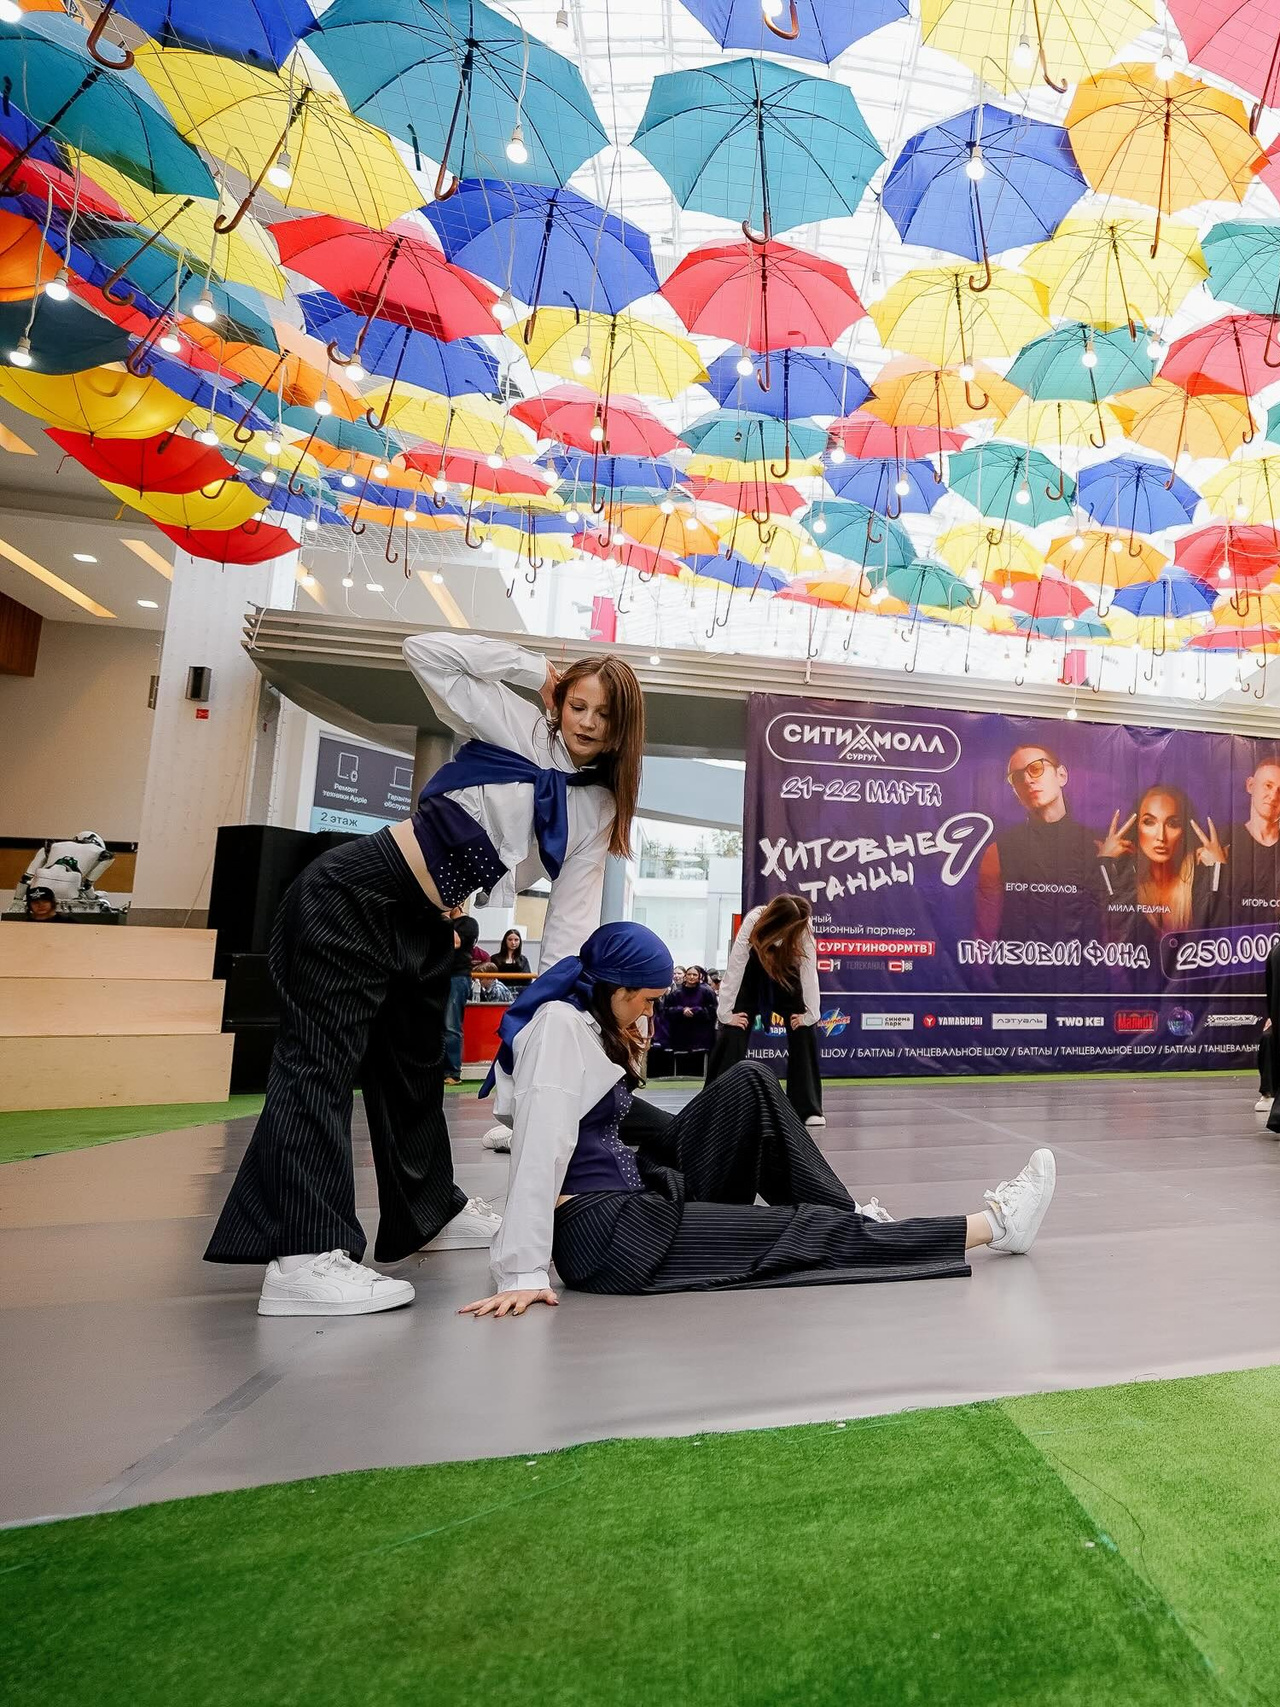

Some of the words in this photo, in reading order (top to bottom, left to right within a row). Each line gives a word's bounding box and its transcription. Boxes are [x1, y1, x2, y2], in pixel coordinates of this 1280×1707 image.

[783, 723, 852, 746] СИТИ
[873, 731, 945, 754] МОЛЛ
[846, 752, 878, 762] СУРГУТ
[334, 782, 359, 794] Ремонт
[780, 775, 862, 802] 21-22
[865, 779, 943, 807] МАРТА
[350, 794, 368, 805] Apple
[320, 811, 328, 822] 2
[330, 815, 358, 827] этаж
[759, 832, 943, 881] ХИТОВЫЕ
[798, 861, 914, 902] ТАНЦЫ
[1005, 882, 1028, 892] ЕГОР
[1030, 883, 1078, 894] СОКОЛОВ
[1242, 898, 1268, 907] ИГОРЬ
[1108, 904, 1135, 913] МИЛА
[1137, 904, 1171, 914] РЕДИНА
[866, 926, 915, 937] партнер:
[958, 939, 1082, 966] ПРИЗОВОЙ
[1084, 940, 1150, 969] ФОНД
[938, 1016, 983, 1026] YAMAGUCHI
[1055, 1016, 1084, 1027] TWO
[821, 1048, 847, 1058] ШОУ
[858, 1048, 895, 1058] БАТТЛЫ
[904, 1047, 982, 1058] ТАНЦЕВАЛЬНОЕ
[985, 1047, 1009, 1057] ШОУ
[1018, 1047, 1052, 1056] БАТТЛЫ
[1060, 1045, 1132, 1056] ТАНЦЕВАЛЬНОЕ
[1134, 1045, 1157, 1054] ШОУ
[1164, 1045, 1197, 1054] БАТТЛЫ
